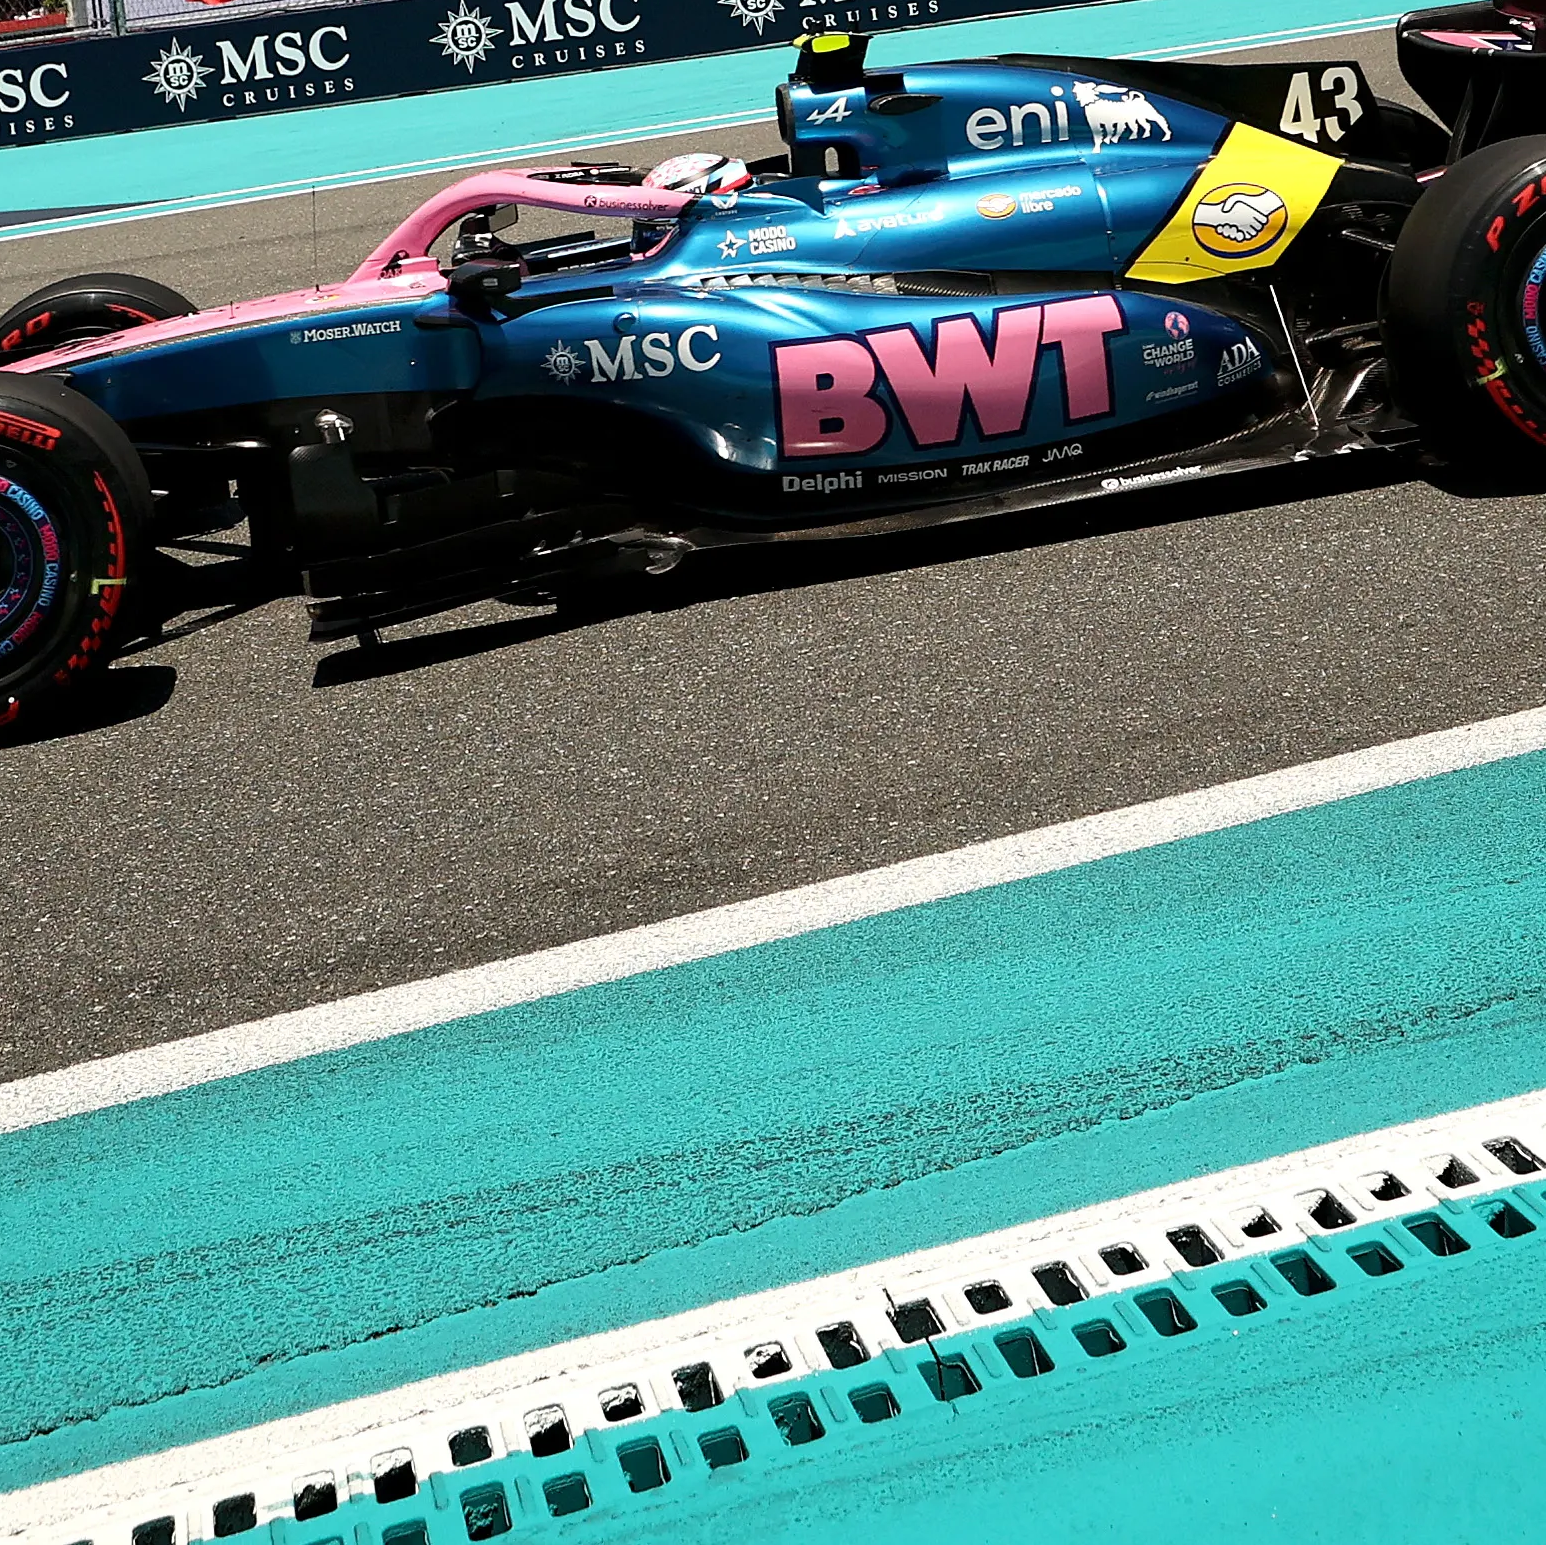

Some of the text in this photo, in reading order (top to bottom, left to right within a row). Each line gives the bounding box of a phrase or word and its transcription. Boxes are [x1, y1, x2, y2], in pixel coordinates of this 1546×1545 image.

[216, 26, 349, 84] MSC
[512, 39, 646, 69] CRUISES
[222, 77, 354, 107] CRUISES
[1280, 66, 1363, 144] 43
[966, 85, 1069, 150] eni
[599, 196, 669, 212] businessolver
[1018, 185, 1082, 201] mercado
[1022, 199, 1054, 214] libre
[858, 202, 945, 233] avature
[748, 226, 786, 242] MODO
[750, 237, 796, 255] CASINO
[584, 324, 721, 383] MSC
[1143, 338, 1193, 360] CHANGE
[1155, 350, 1194, 368] WORLD
[1217, 336, 1261, 376] ADA
[771, 292, 1127, 460] BWT
[1217, 360, 1262, 387] COSMETICS
[878, 467, 948, 484] MISSION
[961, 454, 1029, 477] TRAK RACER
[1119, 463, 1203, 488] businessolver
[782, 471, 863, 495] Delphi
[6, 485, 46, 521] CASINO
[38, 563, 59, 606] CASINO
